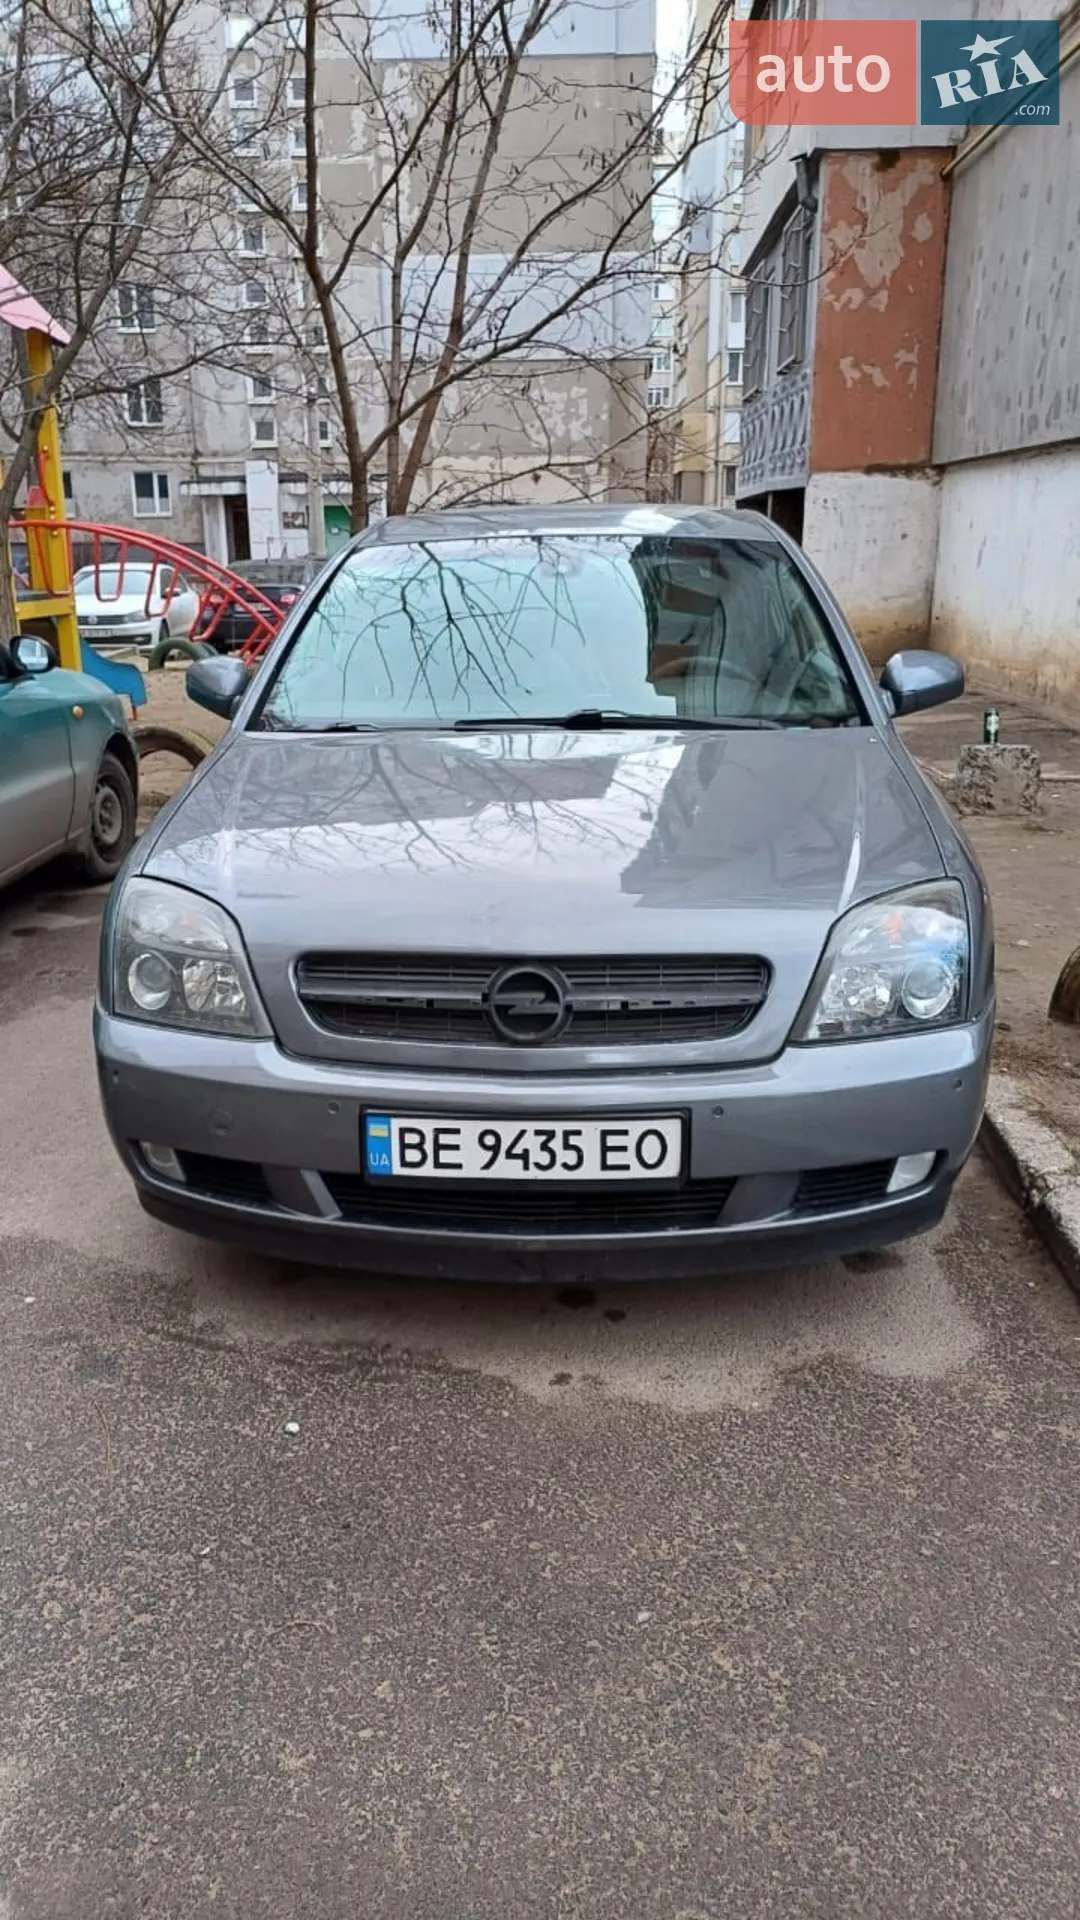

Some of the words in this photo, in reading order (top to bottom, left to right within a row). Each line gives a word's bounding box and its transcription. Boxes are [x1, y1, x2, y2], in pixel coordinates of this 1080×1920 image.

[369, 1152, 390, 1166] UA
[398, 1127, 464, 1170] BE
[477, 1129, 584, 1172] 9435
[599, 1129, 668, 1171] EO
